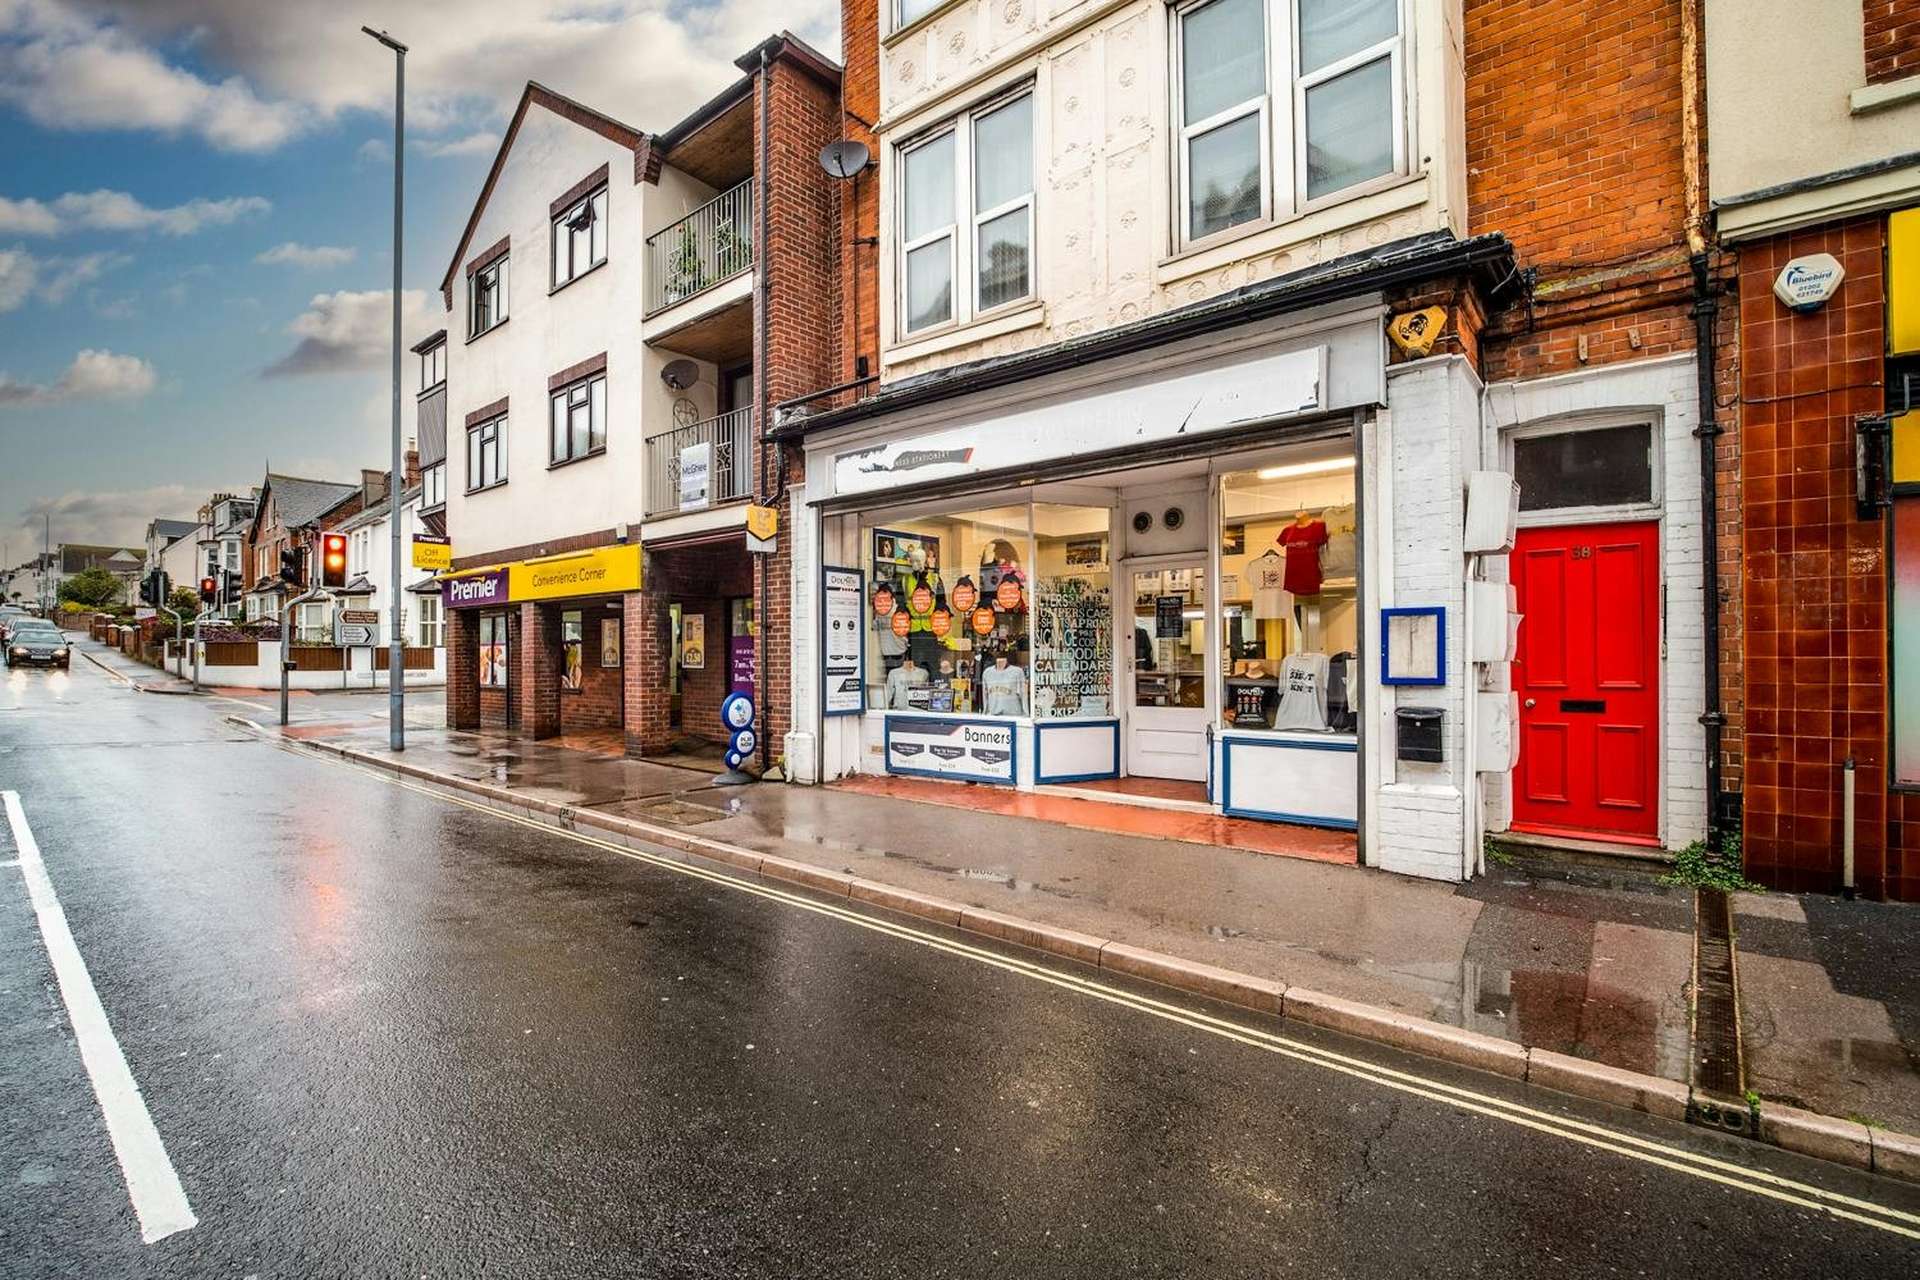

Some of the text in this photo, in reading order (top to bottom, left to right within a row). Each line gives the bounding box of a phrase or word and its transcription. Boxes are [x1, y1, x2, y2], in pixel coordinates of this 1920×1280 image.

[1792, 270, 1833, 284] Bluebird
[416, 554, 448, 565] Licence
[532, 566, 607, 588] Convenience Corner
[450, 576, 499, 601] Premier
[1035, 660, 1113, 672] CALENDARS
[964, 727, 1012, 745] Banners
